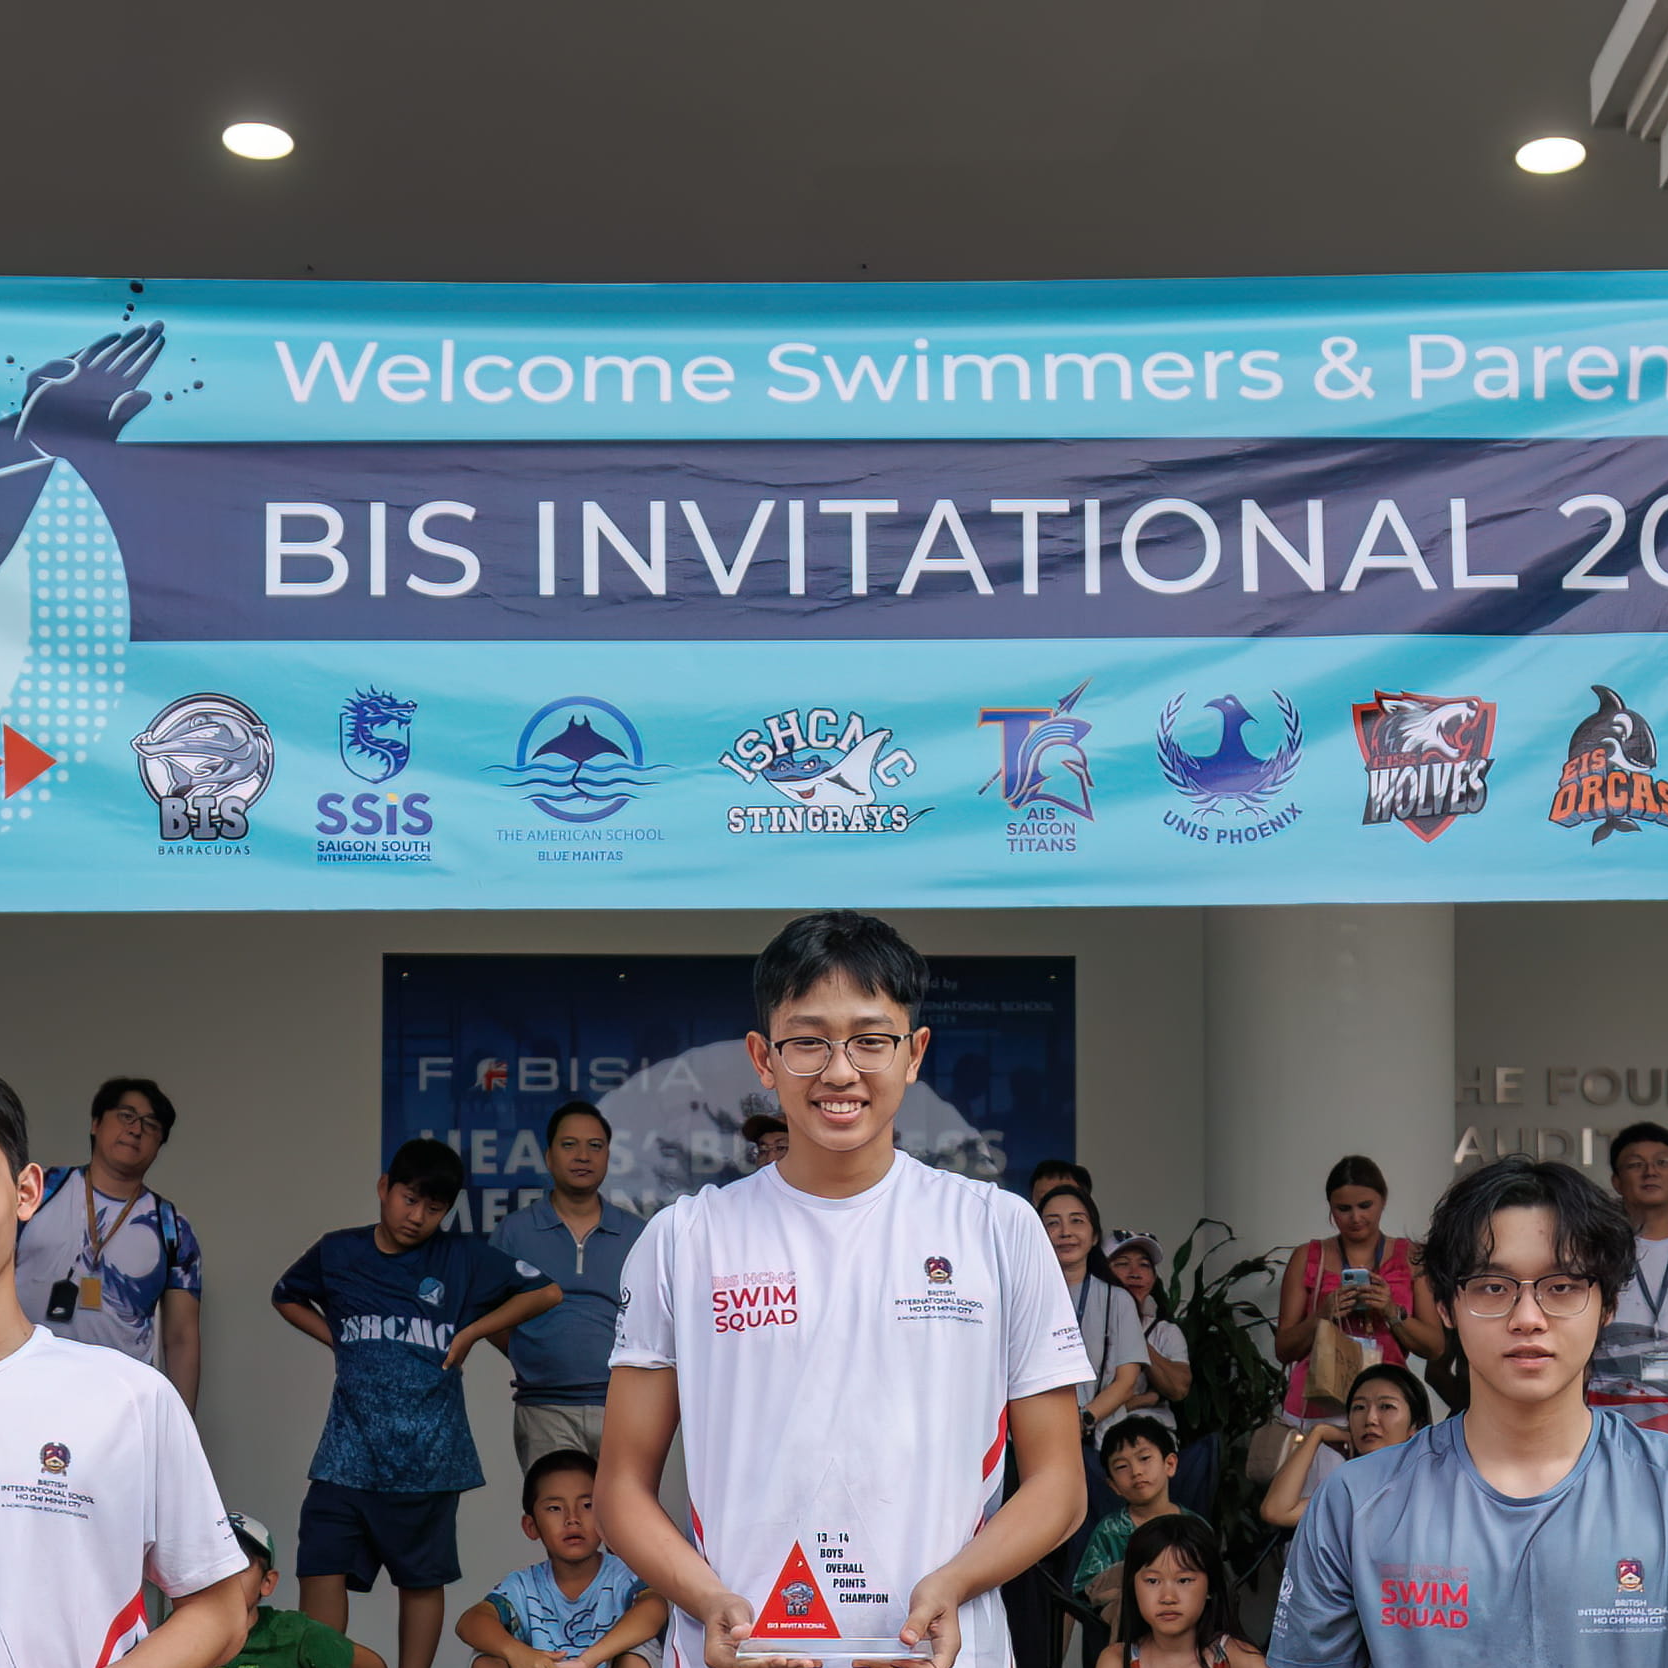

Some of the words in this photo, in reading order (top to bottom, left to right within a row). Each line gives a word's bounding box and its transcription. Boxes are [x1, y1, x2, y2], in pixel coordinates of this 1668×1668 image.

[274, 338, 735, 403] Welcome
[766, 337, 1284, 402] Swimmers
[1313, 335, 1374, 400] &
[264, 500, 482, 597] BIS
[538, 497, 1520, 598] INVITATIONAL
[1561, 747, 1606, 782] EIS
[1366, 759, 1491, 824] WOLVES
[159, 796, 250, 842] BIS
[728, 804, 910, 834] STINGRAYS
[1026, 807, 1056, 821] AIS
[1006, 822, 1077, 836] SAIGON
[1162, 809, 1209, 842] UNIS
[1215, 802, 1304, 845] PHOENIX
[496, 829, 523, 842] THE
[526, 829, 601, 842] AMERICAN
[605, 828, 666, 842] SCHOOL
[157, 845, 251, 857] BARRACUDAS
[316, 840, 377, 853] SAIGON
[381, 840, 432, 853] SOUTH
[1006, 838, 1077, 853] TITANS
[316, 854, 392, 863] INTERNATIONAL
[394, 853, 432, 863] SCHOOL
[537, 851, 570, 863] BLUE
[572, 851, 624, 863] MANTAS
[1456, 1066, 1525, 1104] HE
[712, 1286, 797, 1312] SWIM
[715, 1309, 797, 1334] SQUAD
[1, 1485, 66, 1498] INTERNATIONAL
[816, 1532, 829, 1543] 13
[838, 1532, 850, 1543] 14
[820, 1548, 844, 1559] BOYS
[825, 1563, 865, 1574] OVERALL
[832, 1578, 866, 1589] POINTS
[839, 1593, 889, 1604] CHAMPION
[1379, 1579, 1470, 1608] SWIM
[1380, 1606, 1470, 1630] SQUAD
[1577, 1607, 1647, 1616] INTERNATIONAL
[1593, 1616, 1608, 1624] HO
[1609, 1616, 1624, 1624] CHI
